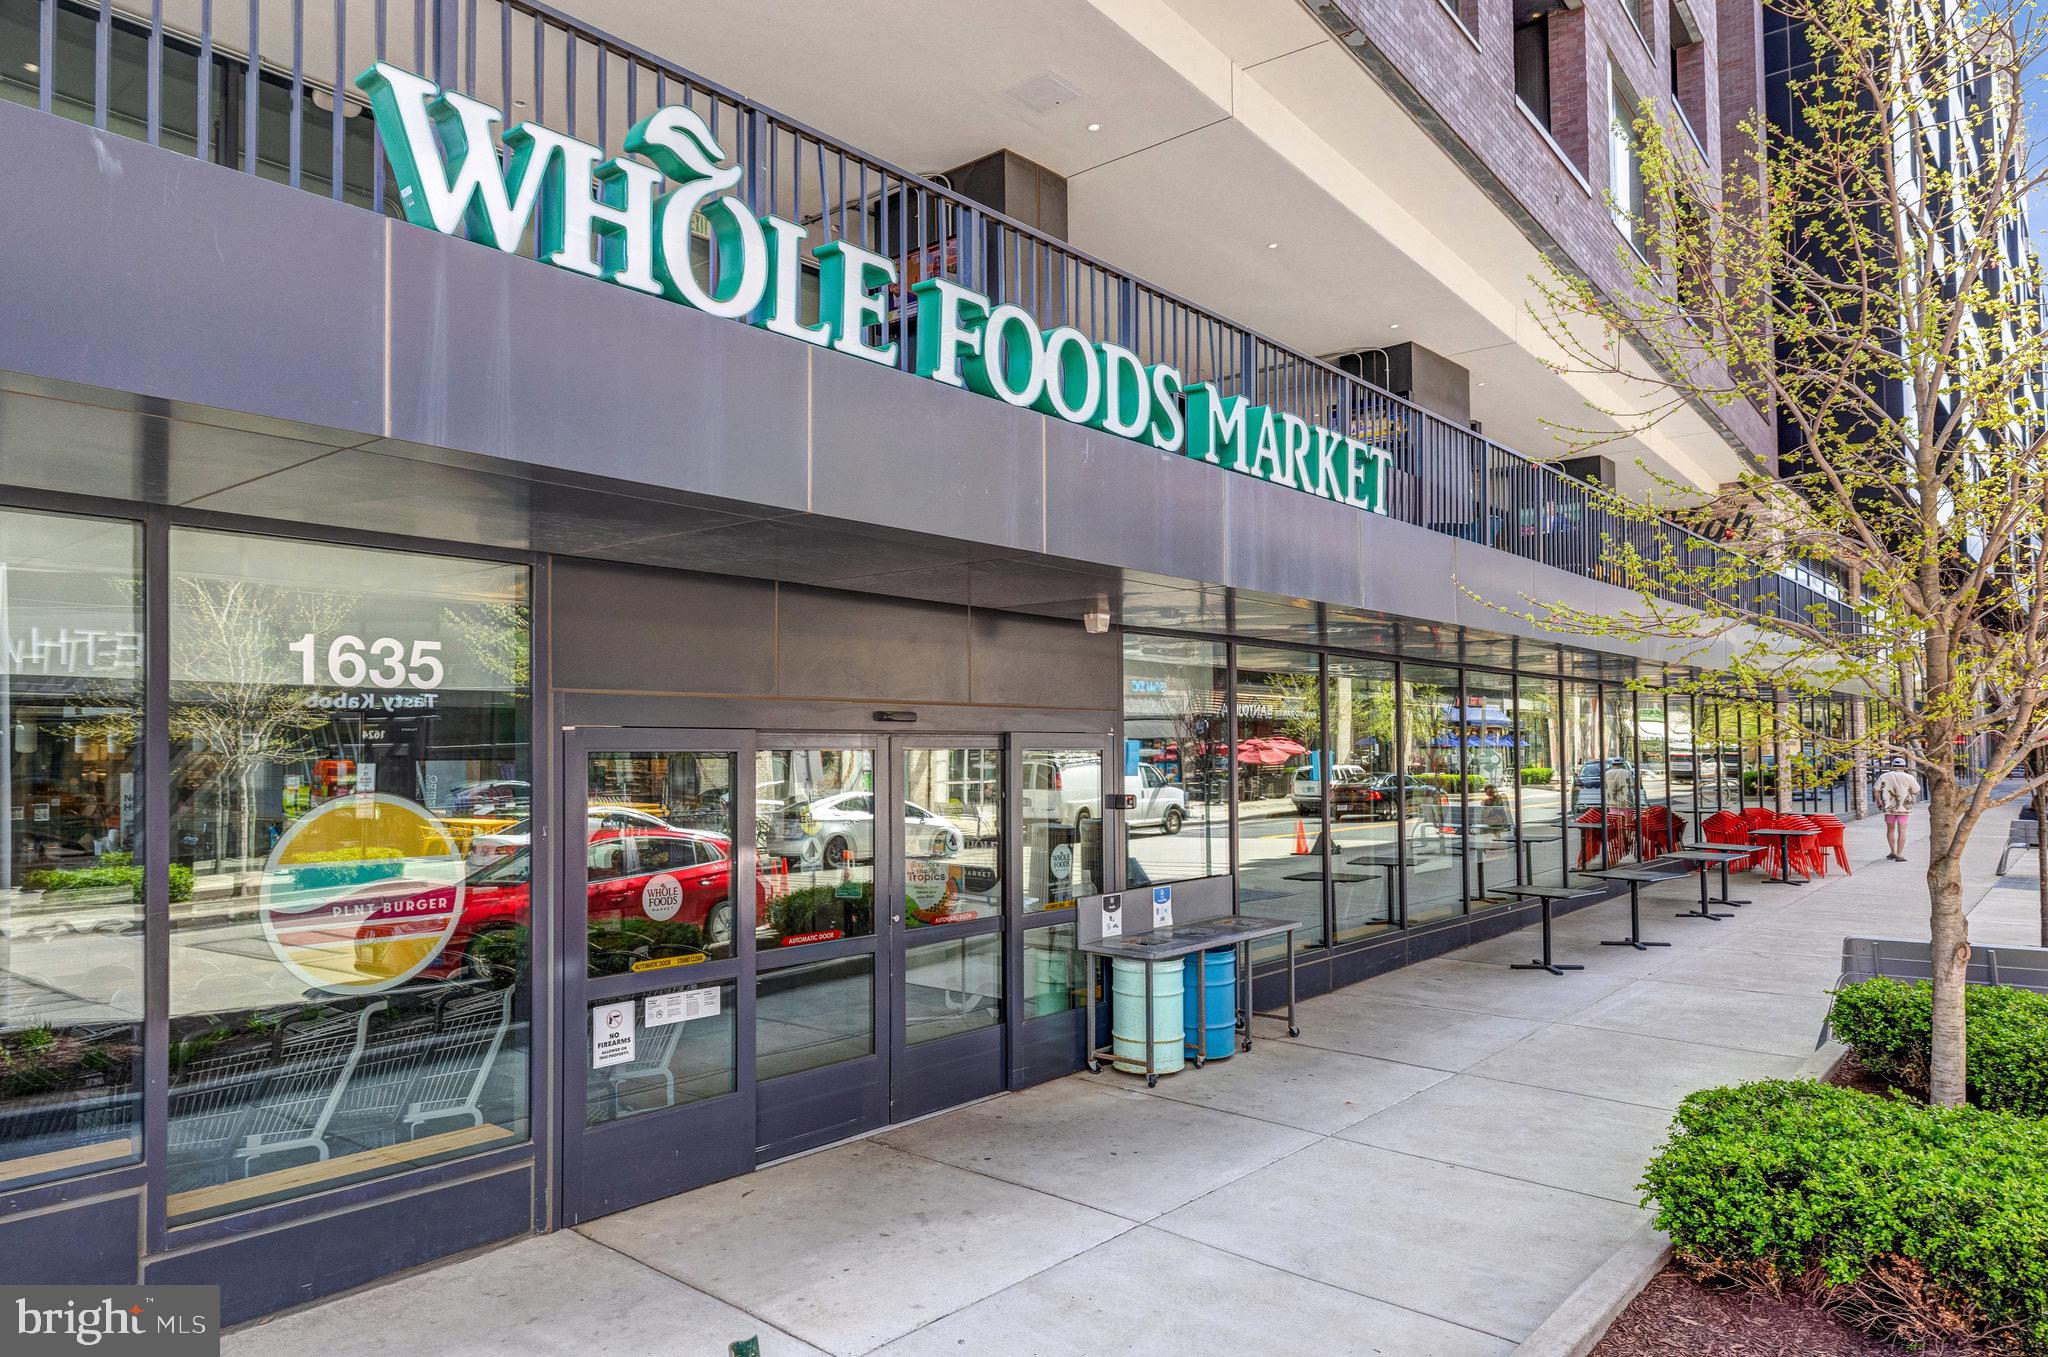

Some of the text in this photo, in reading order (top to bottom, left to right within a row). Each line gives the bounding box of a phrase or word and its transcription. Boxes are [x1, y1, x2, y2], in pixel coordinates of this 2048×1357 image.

[357, 61, 1393, 517] WHOLE FOODS MARKET
[288, 634, 444, 690] 1635
[907, 872, 946, 883] Tropics
[647, 884, 679, 898] WHOLE
[332, 897, 448, 918] PLNT BURGER
[648, 896, 678, 907] FOODS
[960, 912, 972, 920] DOOR
[788, 932, 834, 945] AUTOMATIC DOOR
[634, 961, 659, 970] AUTOMATIC
[659, 959, 671, 967] DOOR
[676, 956, 690, 964] STAND
[597, 1036, 631, 1050] FIREARMS
